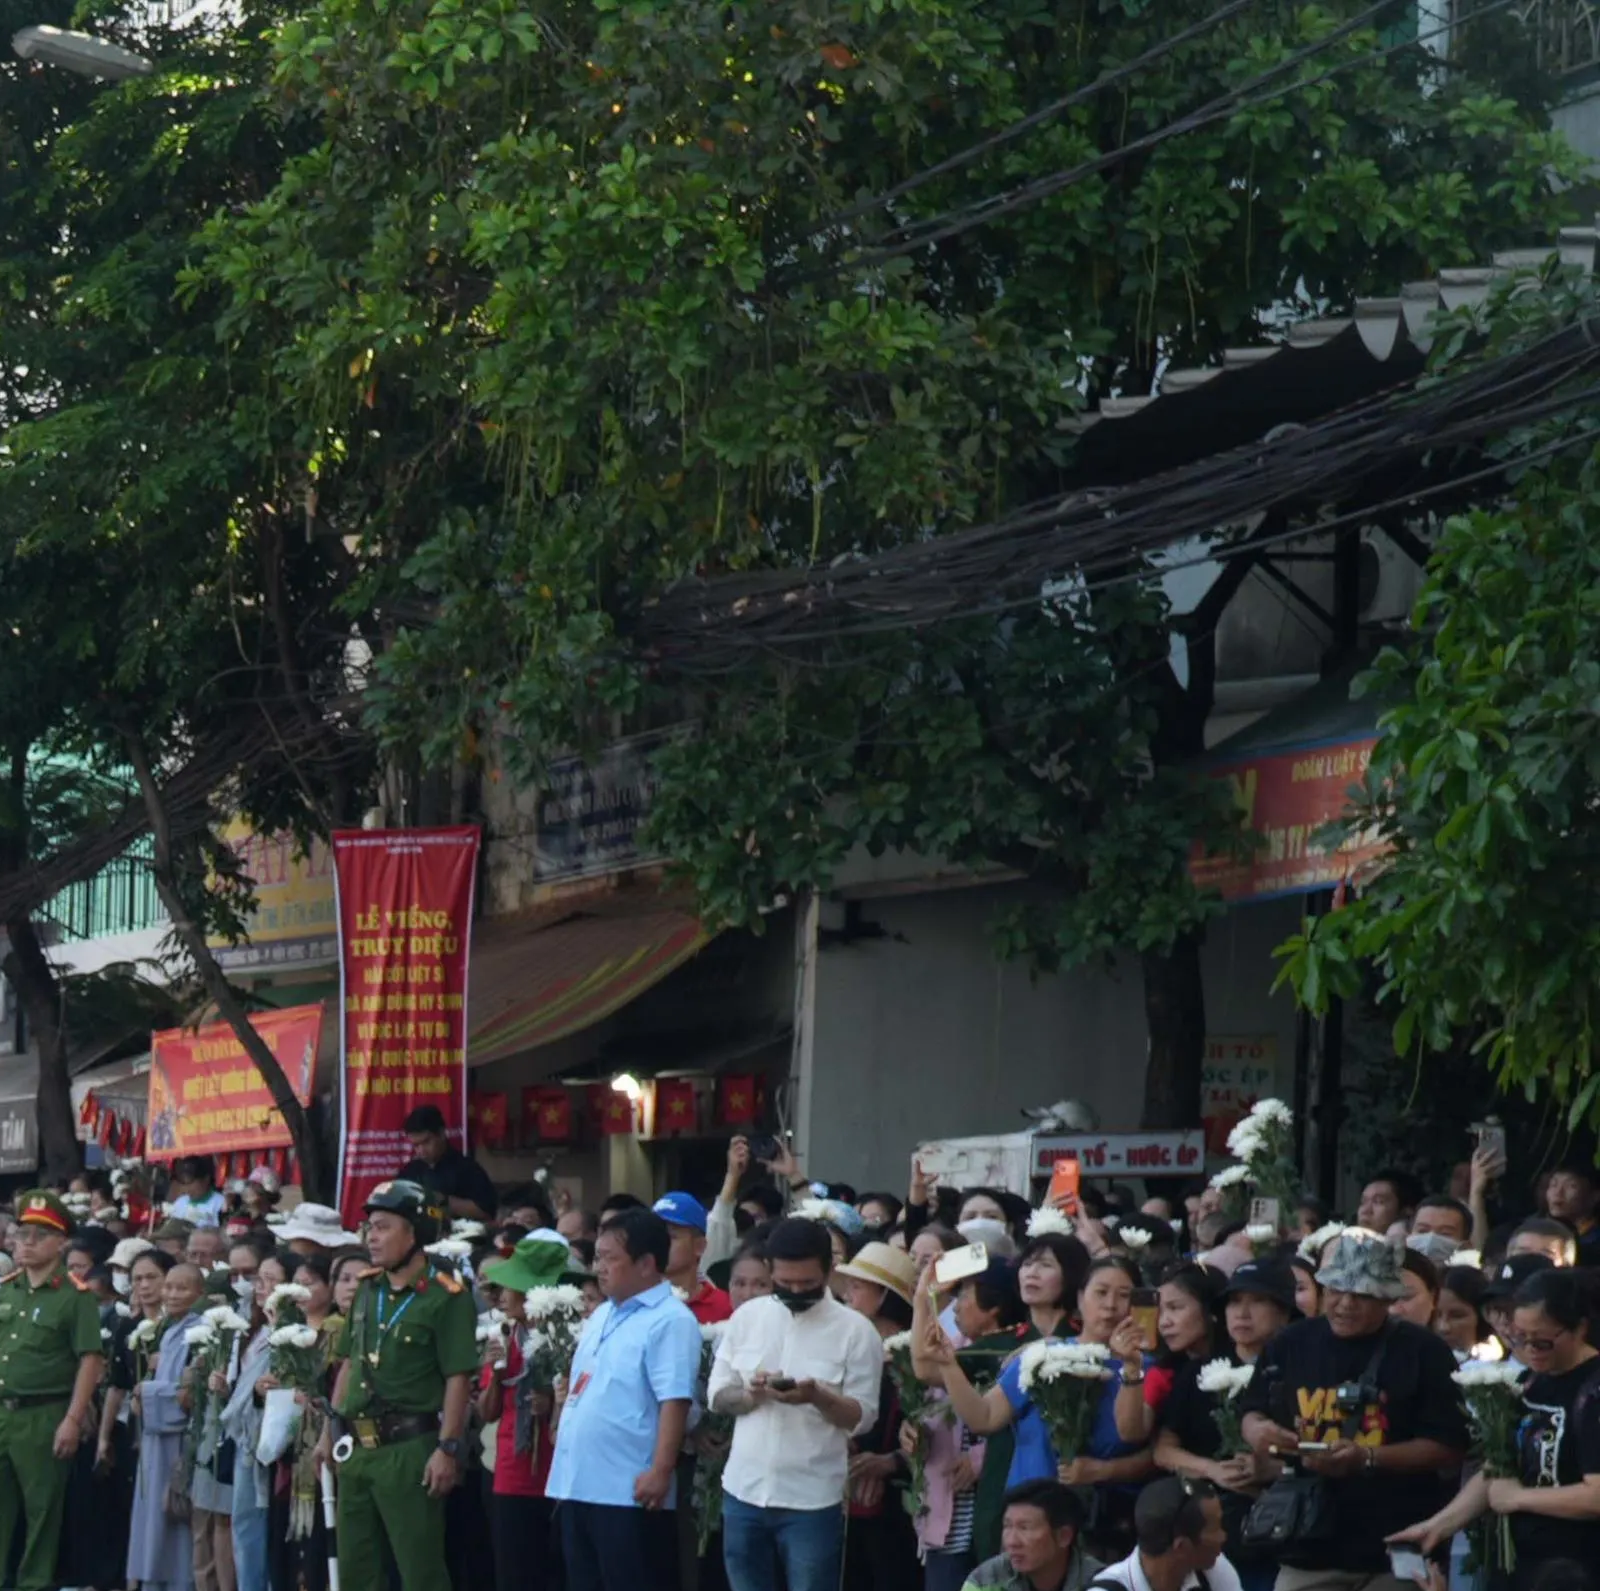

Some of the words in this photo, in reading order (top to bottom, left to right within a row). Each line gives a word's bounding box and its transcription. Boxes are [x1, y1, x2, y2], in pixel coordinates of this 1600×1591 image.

[356, 903, 380, 931] LỄ
[385, 904, 452, 931] VIẾNG,
[351, 937, 405, 956] TRUY
